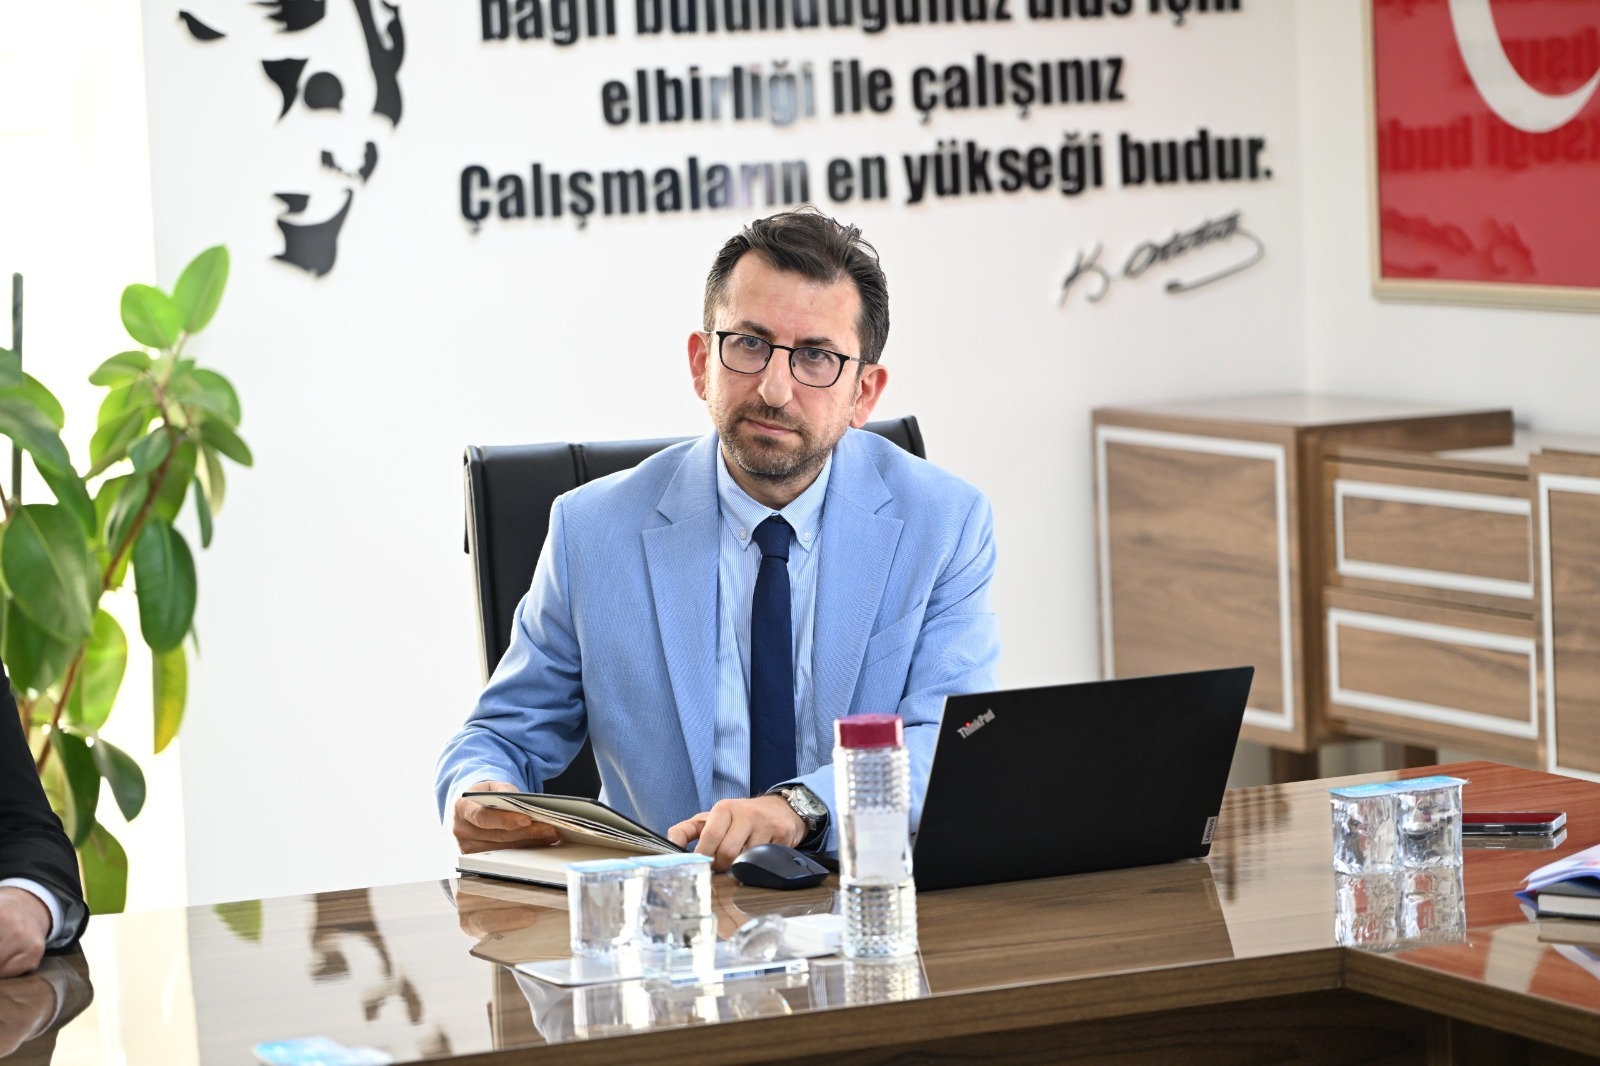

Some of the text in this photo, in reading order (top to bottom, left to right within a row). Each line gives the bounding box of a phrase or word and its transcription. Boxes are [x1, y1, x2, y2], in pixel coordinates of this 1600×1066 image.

[601, 53, 1126, 127] elbirliği ile çalışınız
[460, 128, 1273, 232] Çalışmaların en yükseği budur.
[957, 708, 996, 739] ThinkPad
[1203, 818, 1215, 843] Lenovo
